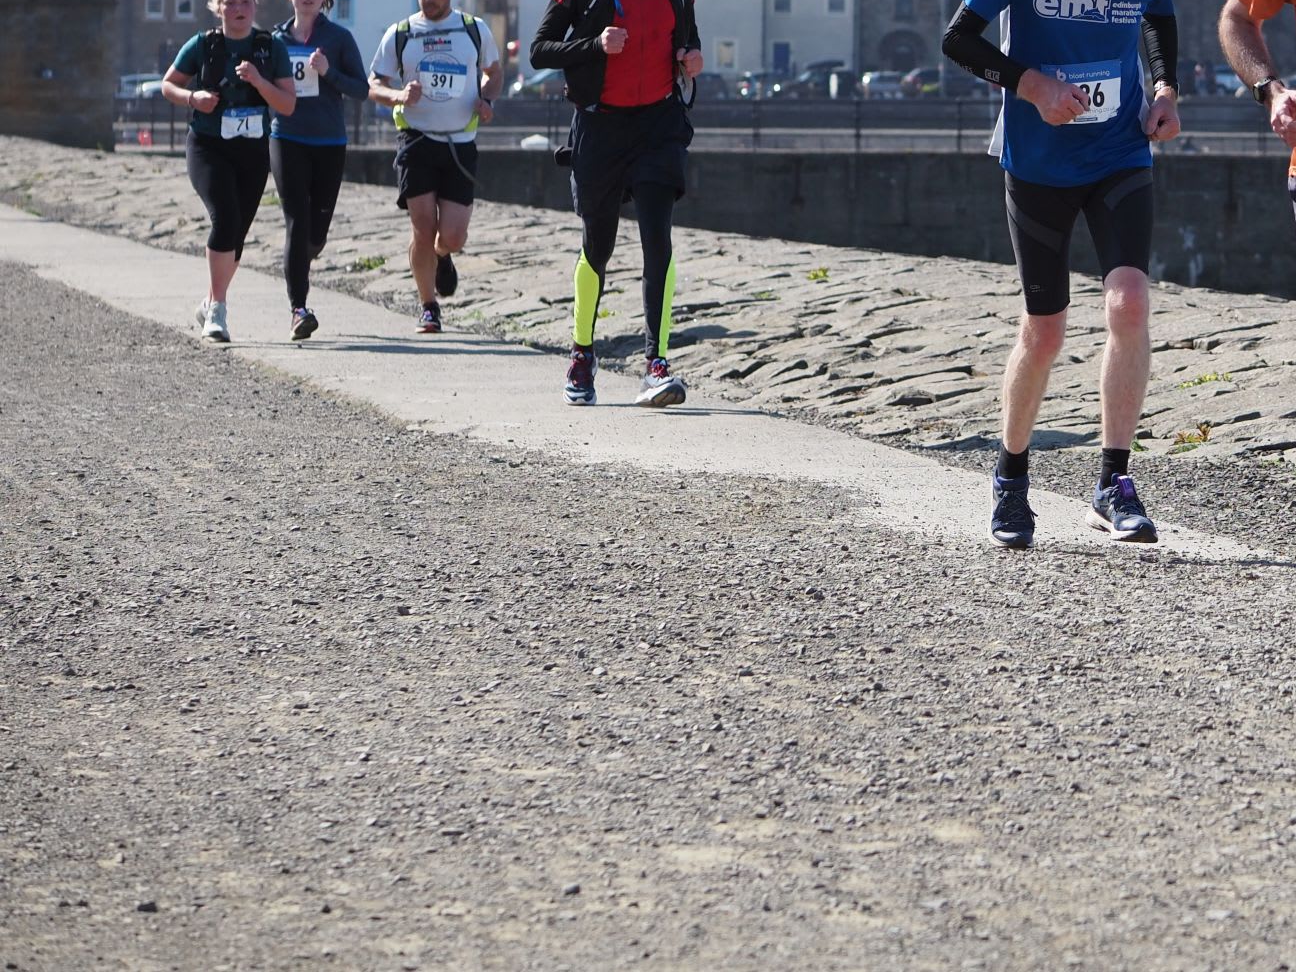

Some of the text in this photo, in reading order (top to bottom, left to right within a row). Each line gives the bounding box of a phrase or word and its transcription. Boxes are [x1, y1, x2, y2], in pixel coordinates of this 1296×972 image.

[1111, 16, 1137, 24] festival
[431, 73, 454, 89] 391
[237, 117, 249, 131] 71
